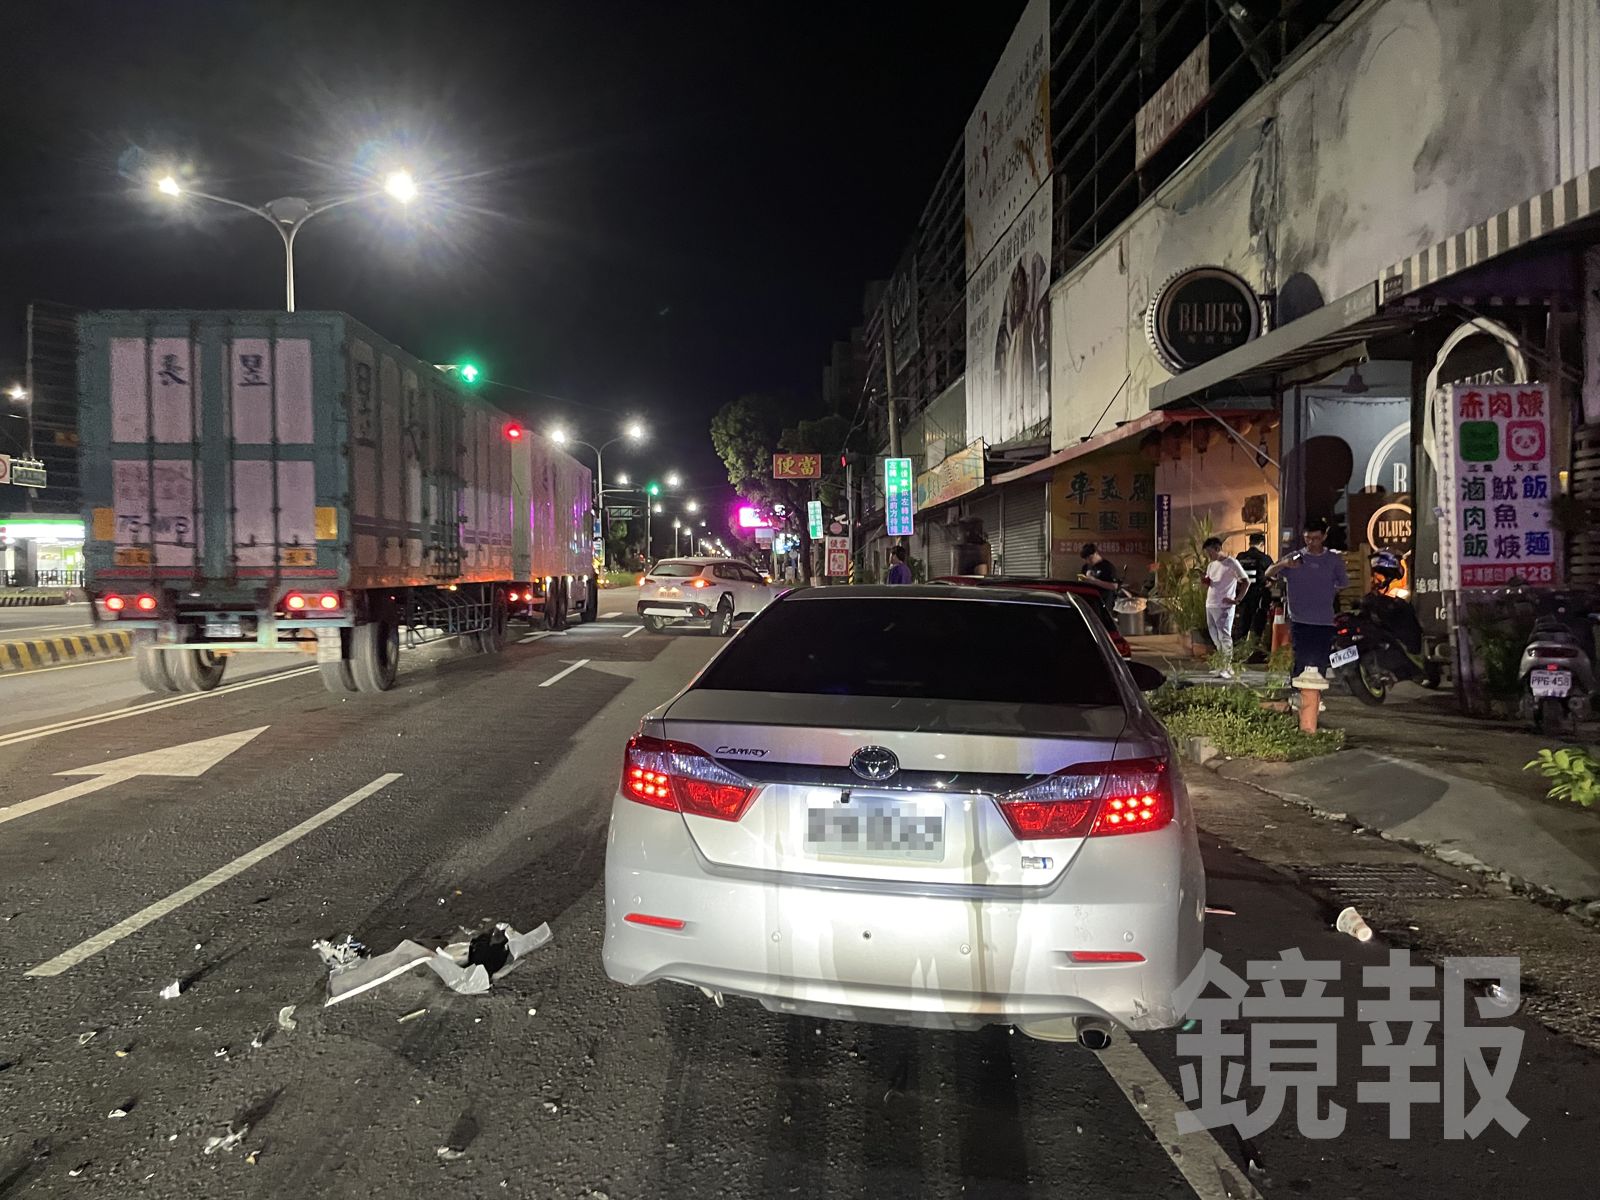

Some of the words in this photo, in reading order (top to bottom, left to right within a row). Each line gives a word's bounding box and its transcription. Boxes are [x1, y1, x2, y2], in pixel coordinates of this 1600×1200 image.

[1179, 302, 1243, 333] BLUES
[776, 455, 817, 476] 便當
[1378, 519, 1412, 538] BLUES
[1461, 476, 1489, 558] 滷肉飯
